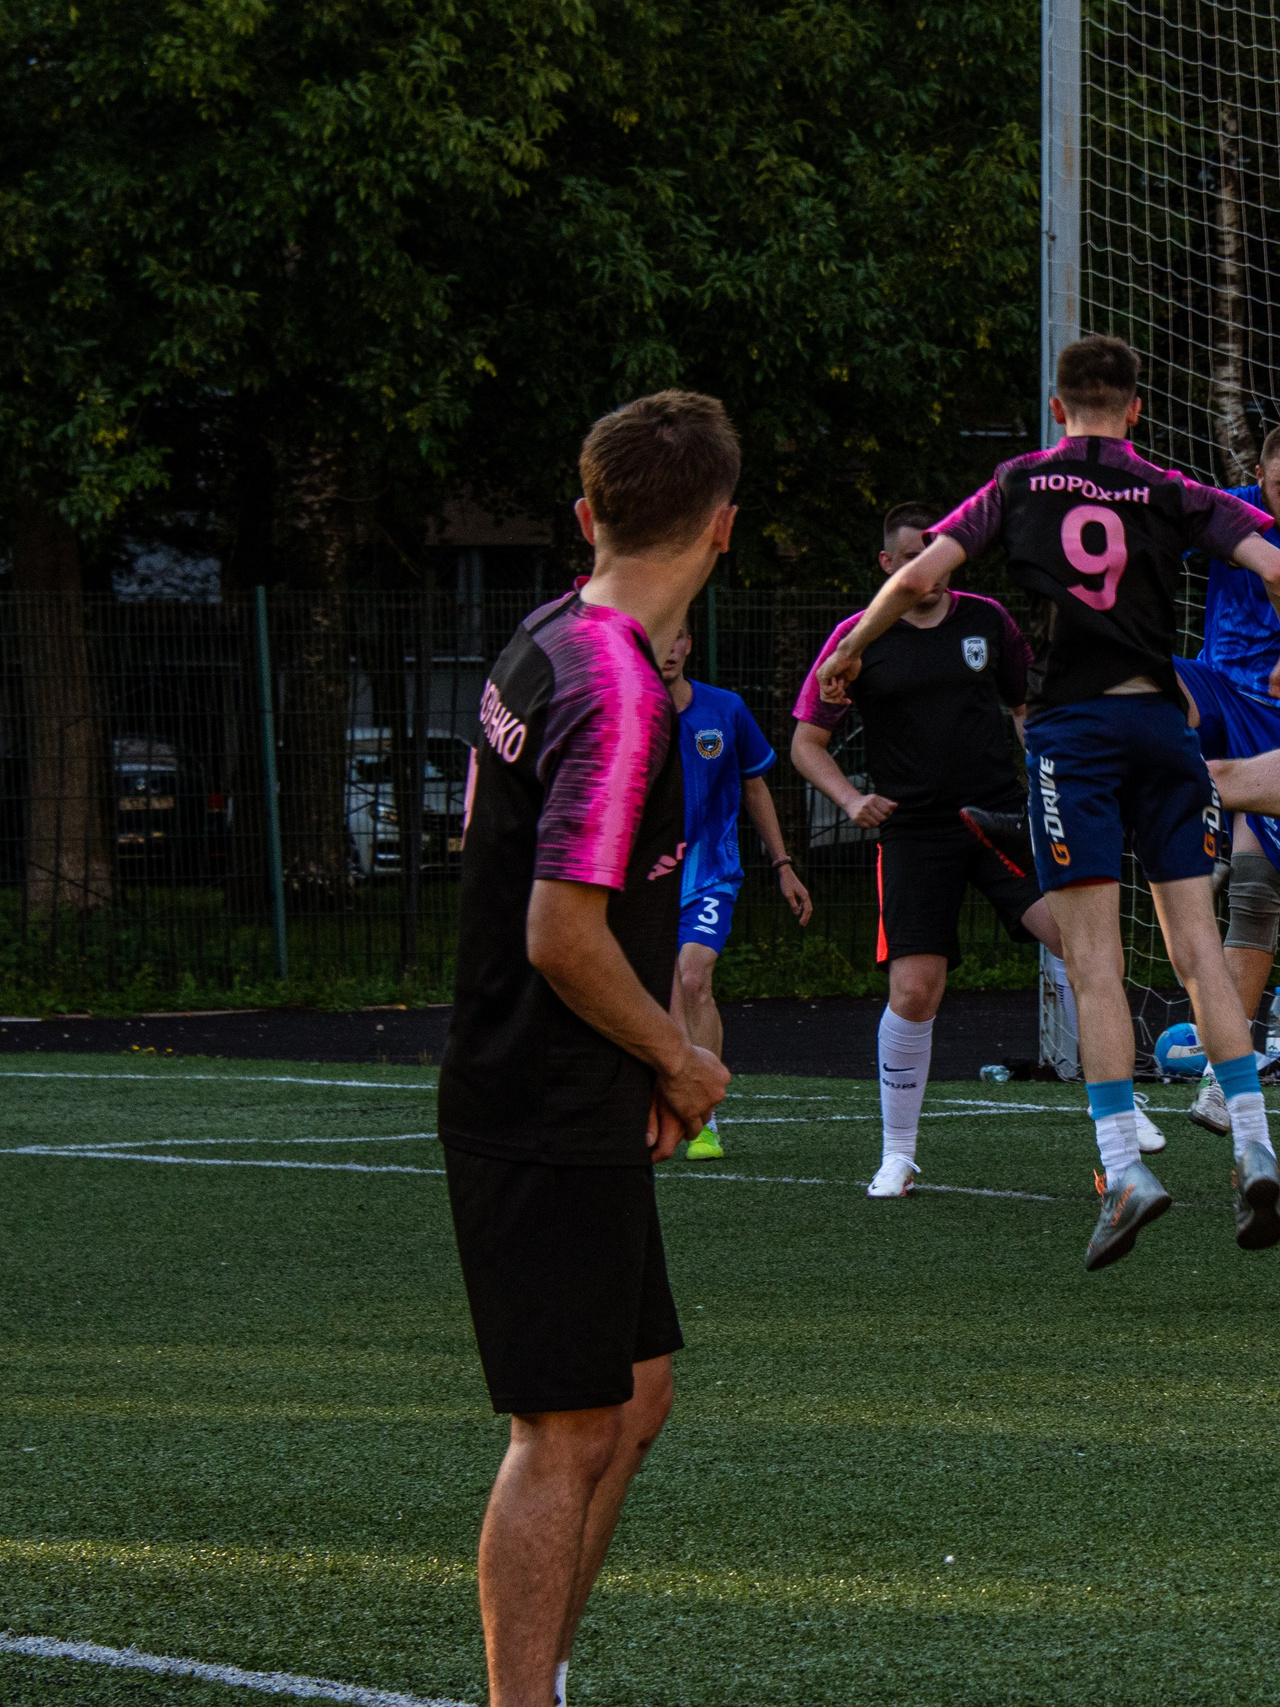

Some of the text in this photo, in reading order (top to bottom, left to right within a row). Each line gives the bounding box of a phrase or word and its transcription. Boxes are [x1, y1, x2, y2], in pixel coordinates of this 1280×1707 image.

[1029, 474, 1150, 504] ПОРОХИН
[1060, 504, 1129, 612] 9
[697, 896, 720, 925] 3
